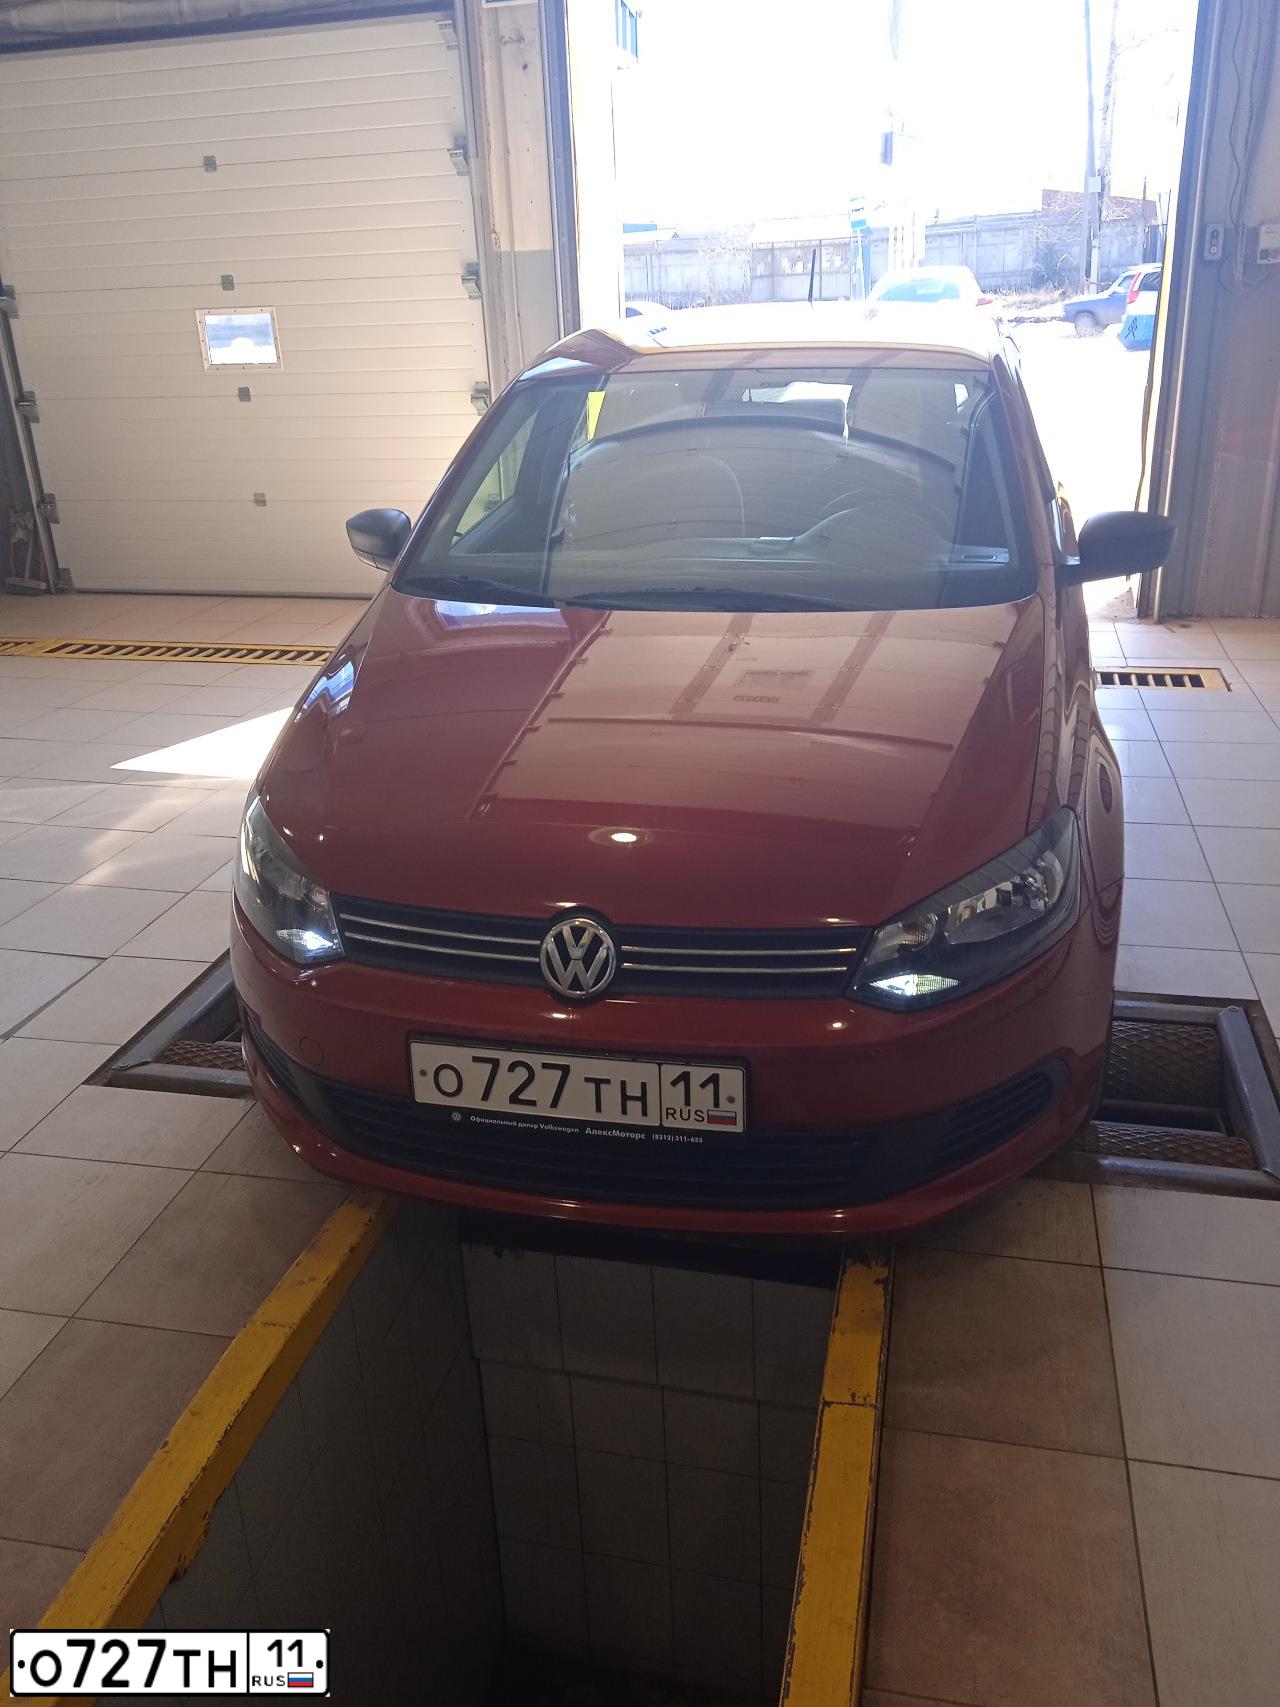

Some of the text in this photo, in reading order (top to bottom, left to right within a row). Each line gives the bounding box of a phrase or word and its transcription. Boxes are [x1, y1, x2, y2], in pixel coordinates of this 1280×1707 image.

[670, 1071, 720, 1109] 11
[665, 1107, 705, 1122] RUS
[539, 1123, 579, 1133] Volkswagen
[585, 1127, 646, 1139] АлексМоторс
